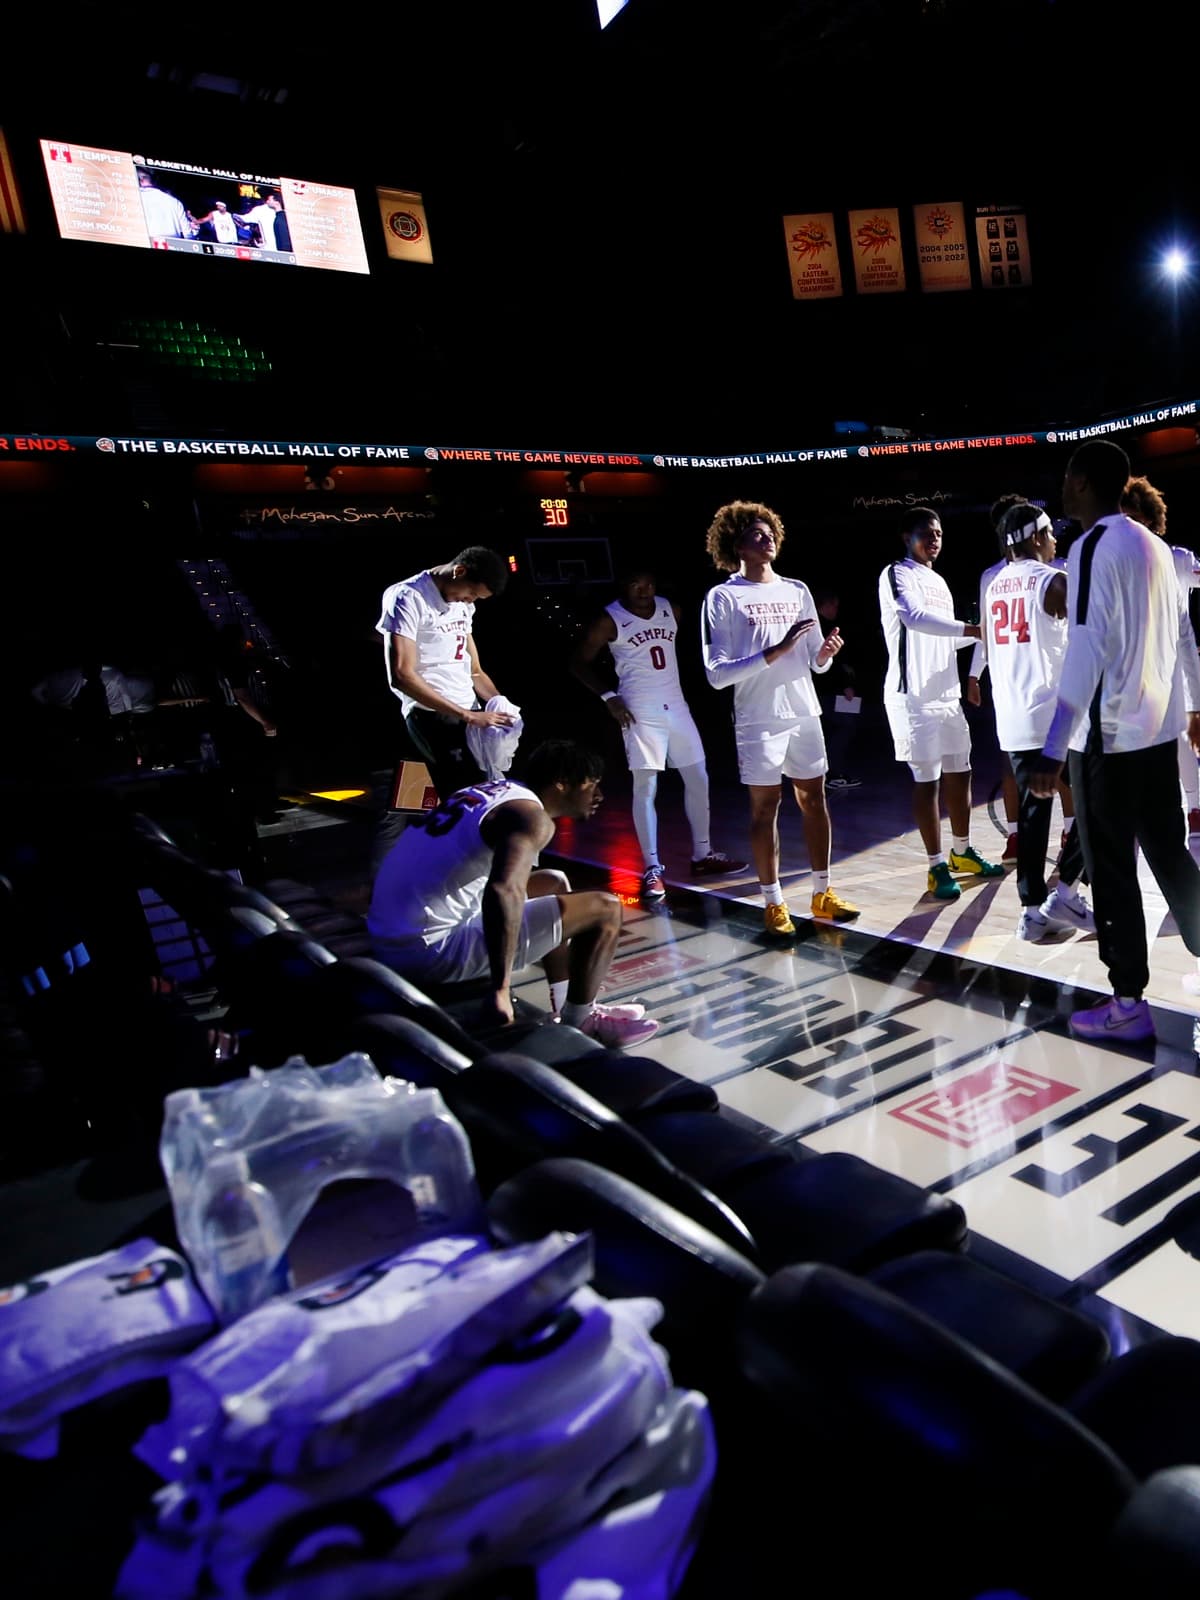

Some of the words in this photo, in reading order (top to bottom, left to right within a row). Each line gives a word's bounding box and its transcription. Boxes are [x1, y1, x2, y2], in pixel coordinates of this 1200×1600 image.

[79, 150, 121, 164] TEMPLE
[146, 158, 211, 175] BASKETBALL
[212, 167, 237, 180] HALL
[239, 172, 254, 182] OF
[1058, 431, 1078, 442] THE
[1079, 419, 1131, 439] BASKETBALL
[1133, 413, 1155, 427] HALL
[1157, 409, 1170, 421] OF
[1171, 403, 1197, 418] FAME
[14, 437, 76, 451] ENDS.
[118, 440, 158, 453] THE
[163, 440, 285, 456] BASKETBALL
[288, 445, 335, 457] HALL
[338, 446, 361, 458] OF
[366, 447, 410, 459] FAME
[869, 444, 909, 456] WHERE
[911, 442, 932, 453] THE
[934, 440, 965, 451] GAME
[967, 437, 1002, 448] NEVER
[1005, 435, 1037, 446] ENDS.
[439, 450, 492, 461] WHERE
[494, 451, 521, 462] THE
[524, 452, 562, 463] GAME
[564, 453, 606, 464] NEVER
[608, 455, 643, 466] ENDS.
[665, 457, 689, 467] THE
[691, 455, 764, 468] BASKETBALL
[766, 452, 796, 464] HALL
[798, 451, 814, 461] OF
[817, 449, 848, 460] FAME
[540, 498, 568, 509] 20:00
[261, 507, 340, 524] Mohegan
[343, 507, 379, 522] Sun
[382, 506, 436, 523] Arena
[545, 508, 568, 526] 30
[745, 602, 801, 615] TEMPLE
[991, 597, 1032, 645] 24
[627, 627, 675, 648] TEMPLE
[454, 634, 466, 661] 2
[649, 645, 667, 671] 0
